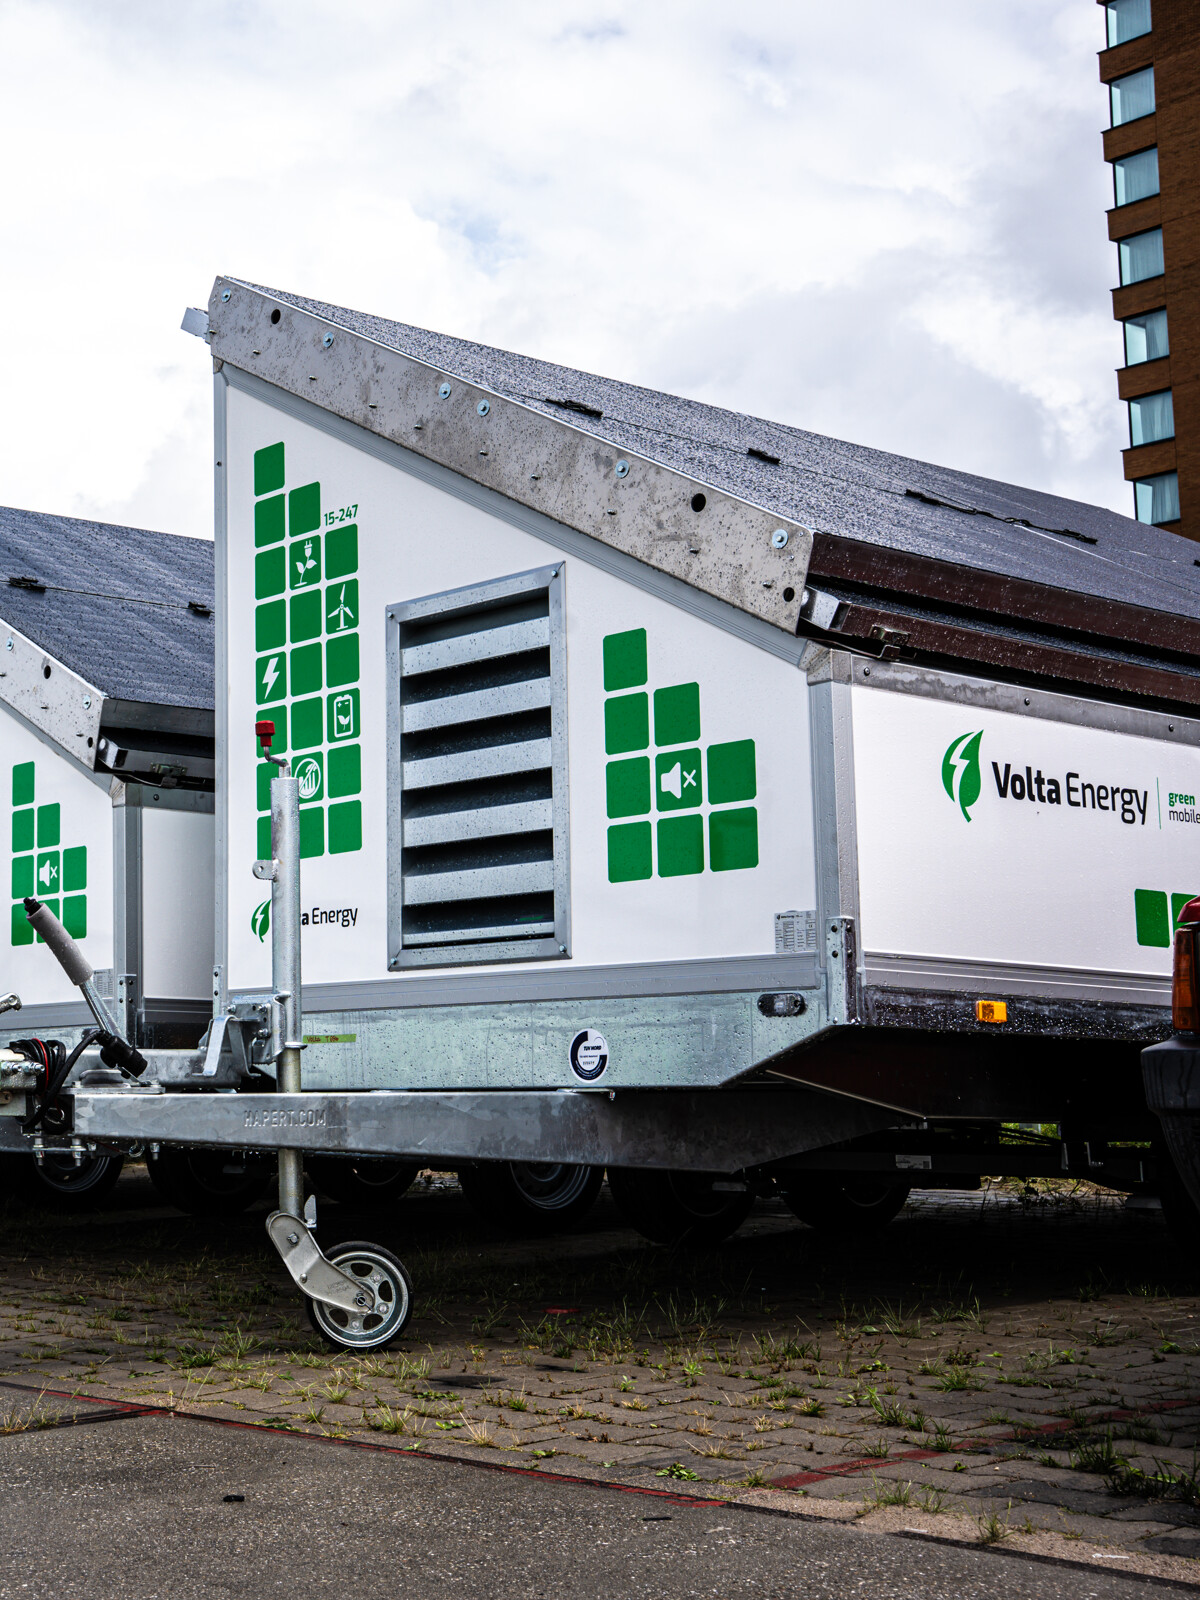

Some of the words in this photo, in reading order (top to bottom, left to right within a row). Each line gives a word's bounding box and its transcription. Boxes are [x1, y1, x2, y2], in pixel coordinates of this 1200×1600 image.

[324, 504, 358, 526] 15-247
[991, 761, 1061, 805] Volta
[1065, 771, 1148, 825] Energy
[1168, 792, 1195, 807] green
[1169, 808, 1200, 824] mobile
[312, 907, 358, 928] Energy
[243, 1109, 326, 1127] HAPERT.COM
